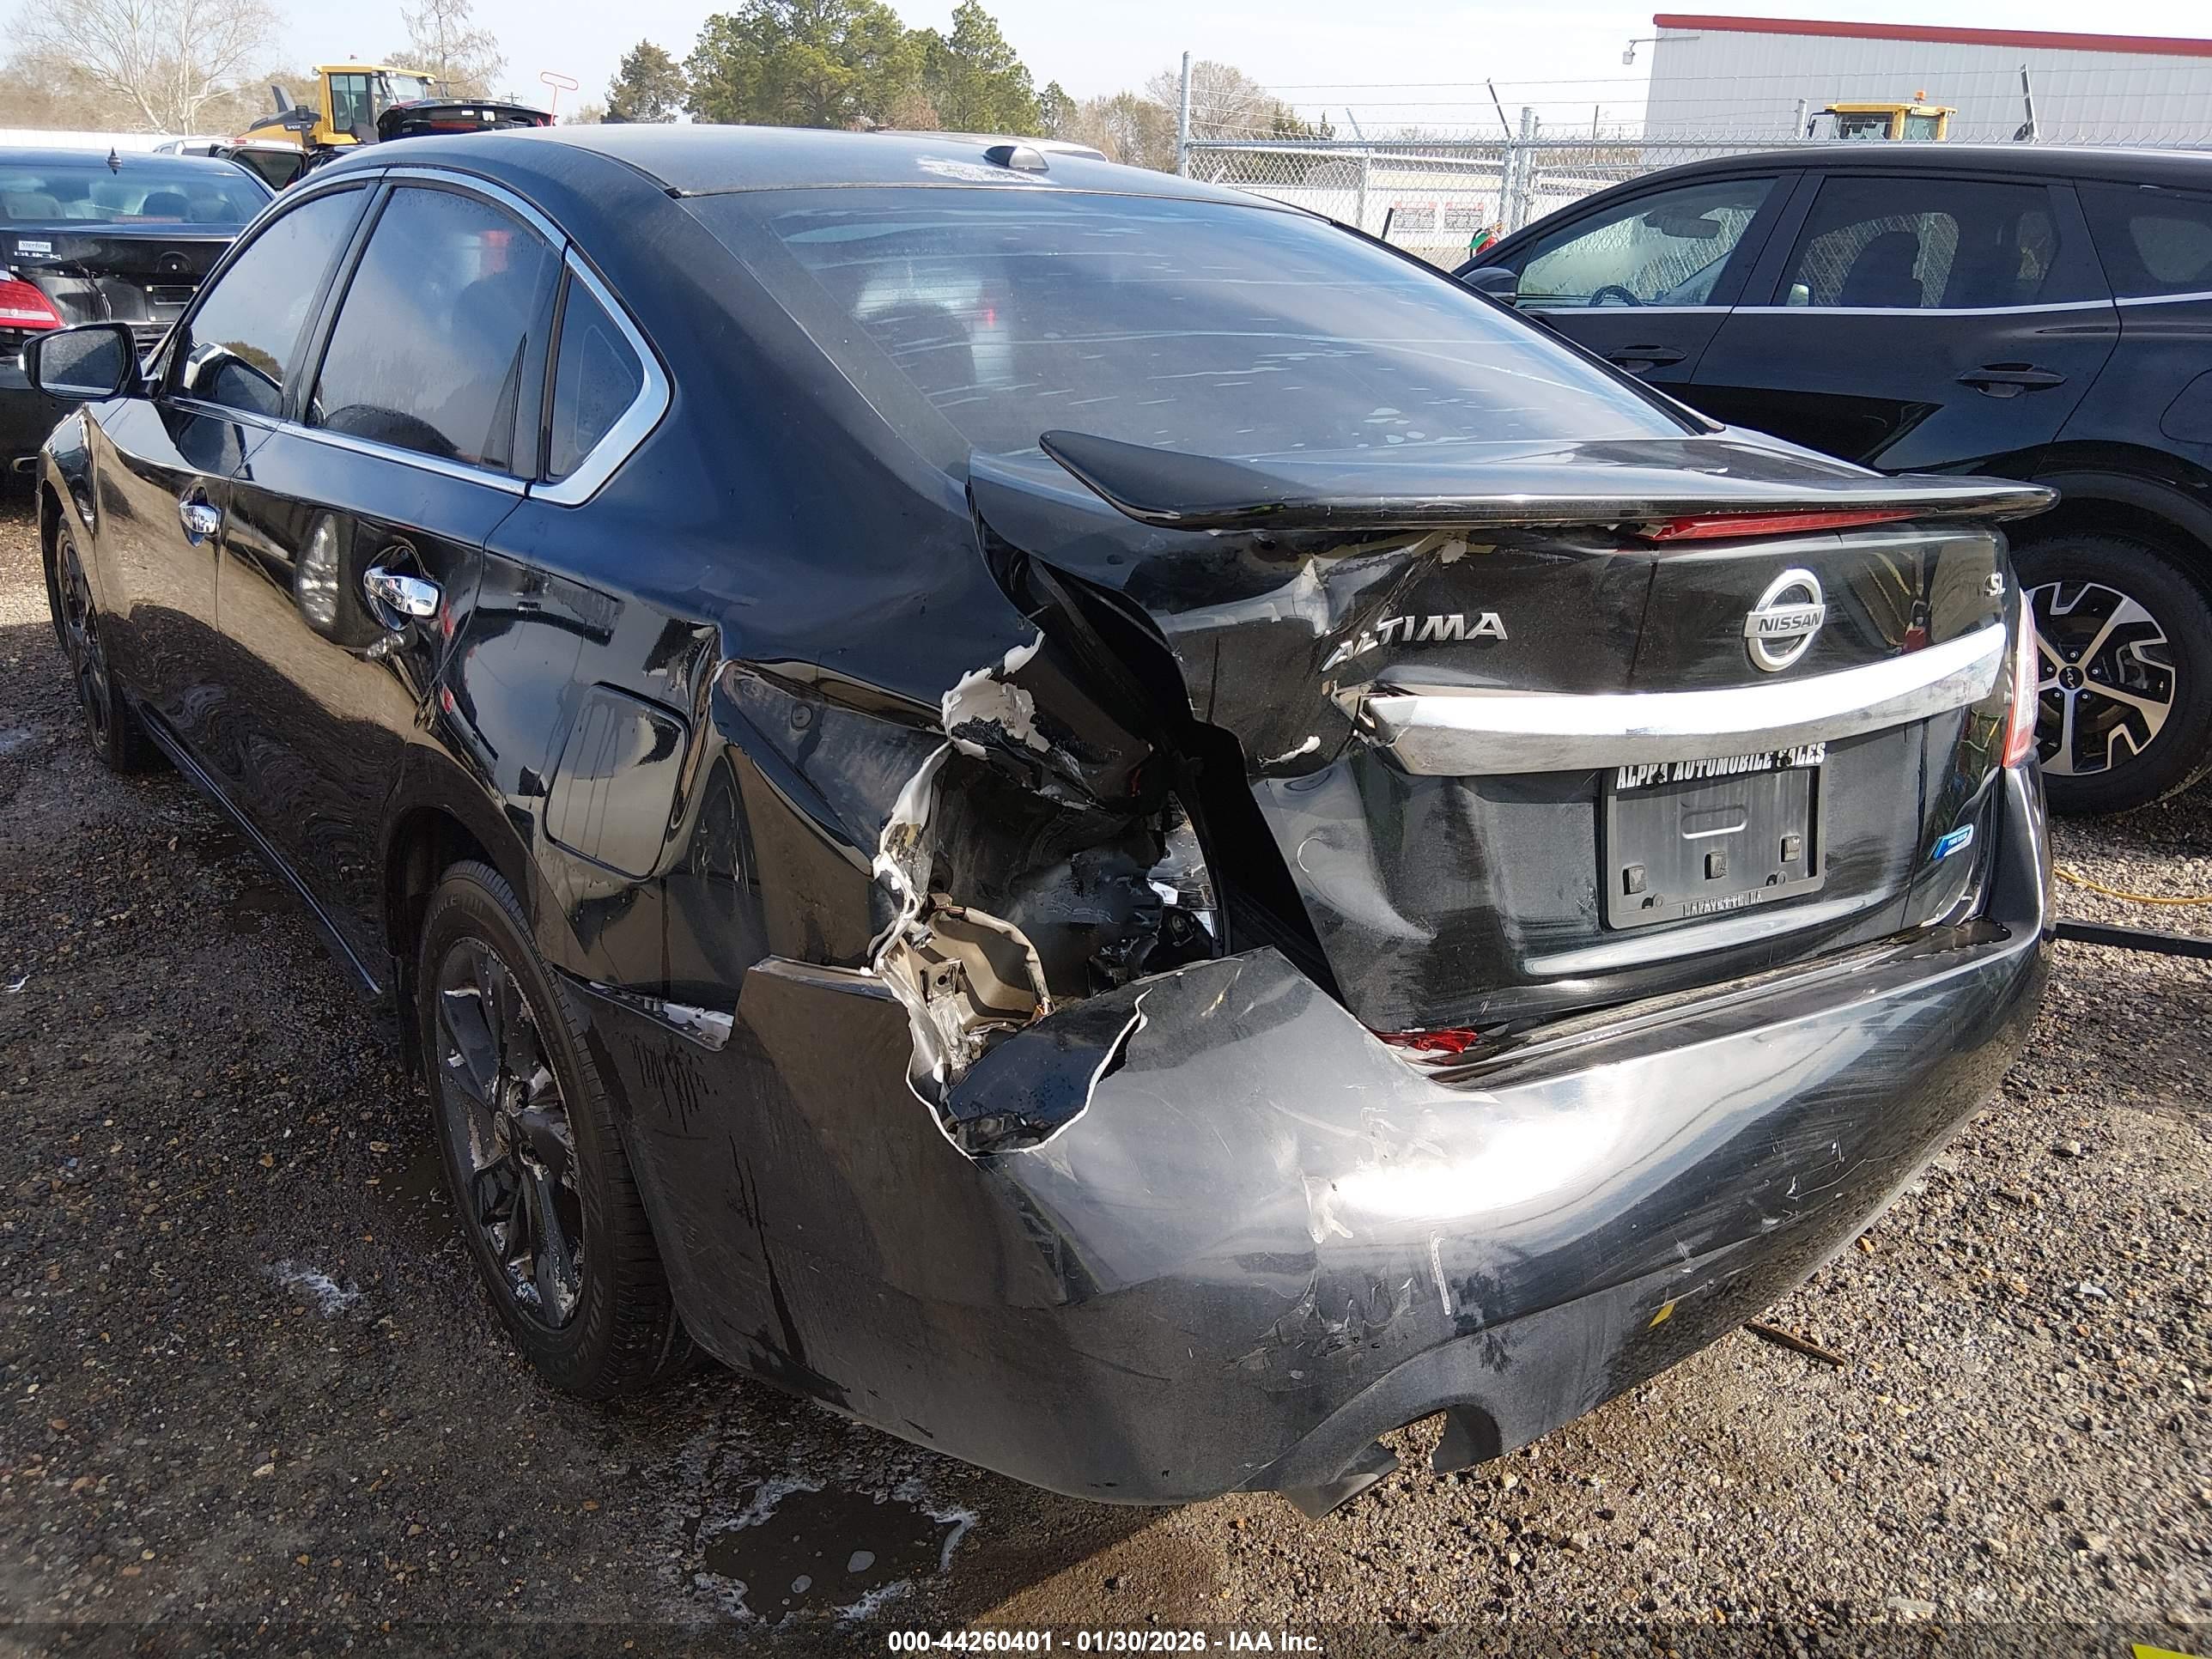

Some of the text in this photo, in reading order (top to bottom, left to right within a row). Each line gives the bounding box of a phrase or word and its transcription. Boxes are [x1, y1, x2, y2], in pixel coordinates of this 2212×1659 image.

[14, 251, 62, 260] BUICK
[1984, 572, 2006, 596] SL
[1758, 612, 1821, 632] NISSAN
[1321, 611, 1509, 672] ALTIMA
[1672, 750, 1773, 781] AUTOMOBILE
